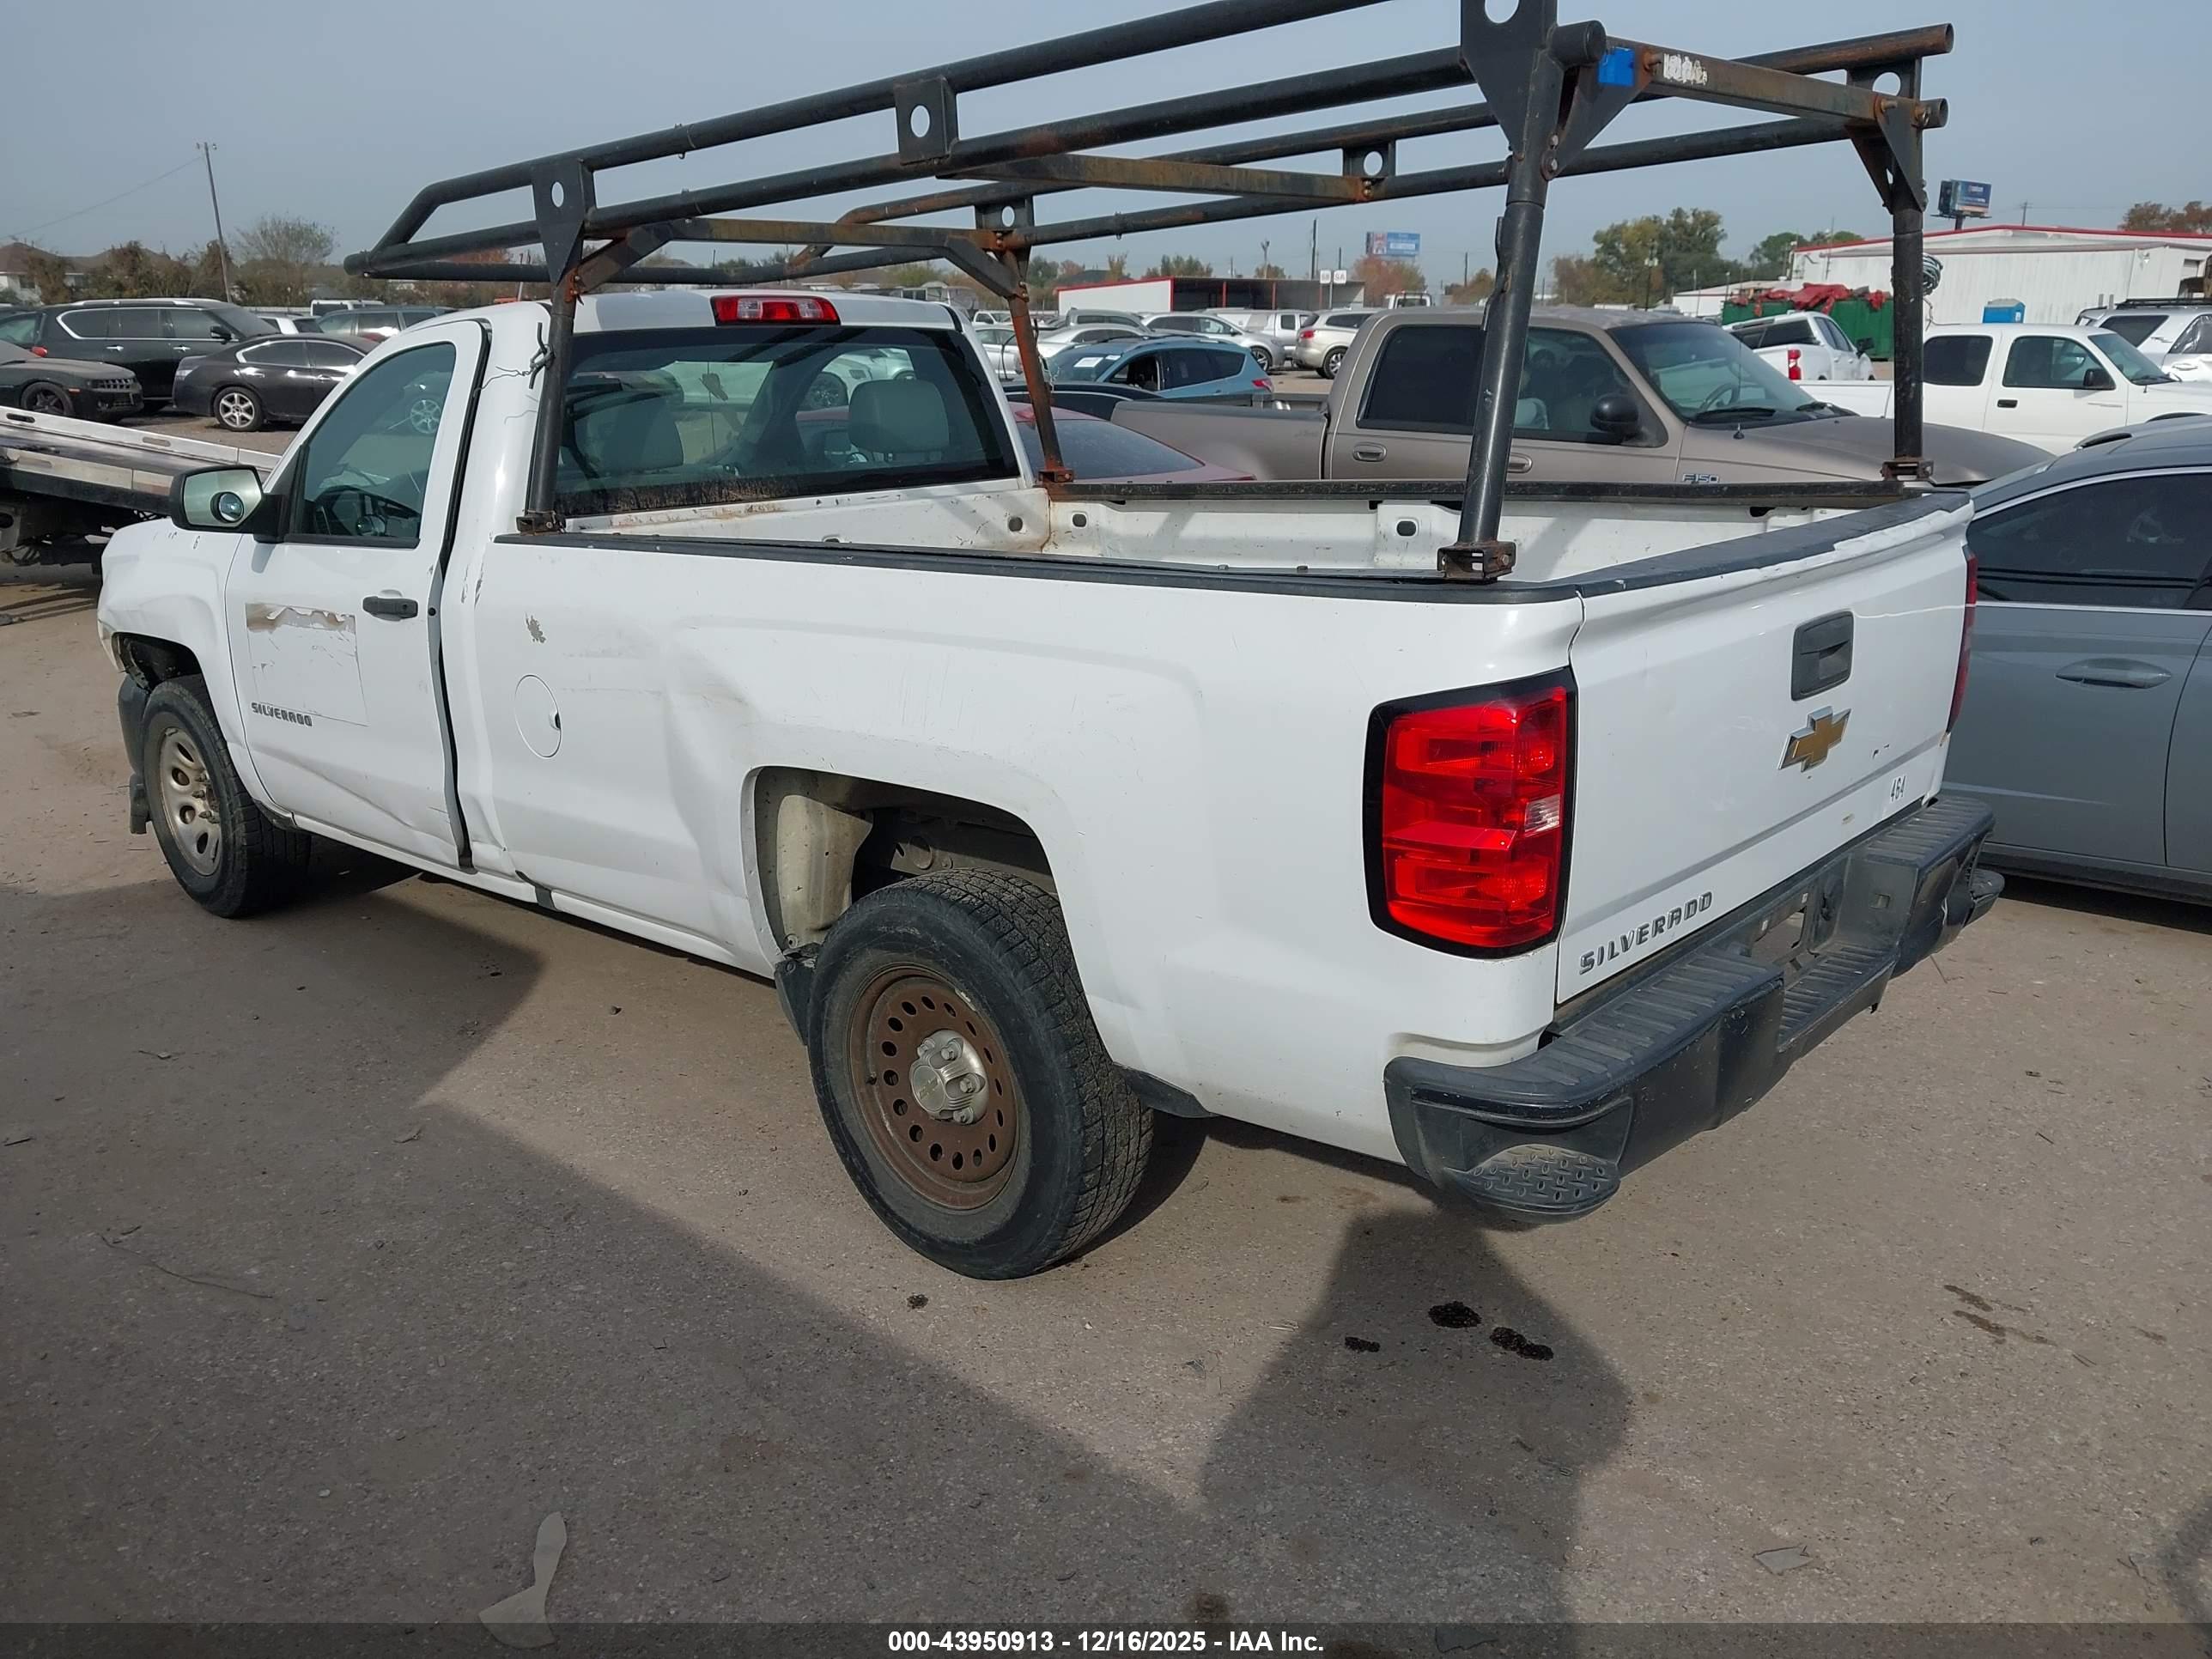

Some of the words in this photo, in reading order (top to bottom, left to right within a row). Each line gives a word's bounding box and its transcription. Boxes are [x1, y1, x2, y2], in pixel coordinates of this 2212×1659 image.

[1682, 473, 1719, 483] F150
[251, 702, 313, 726] SILVERADO
[1890, 775, 1906, 802] 464
[1579, 891, 1712, 975] SILVERADO
